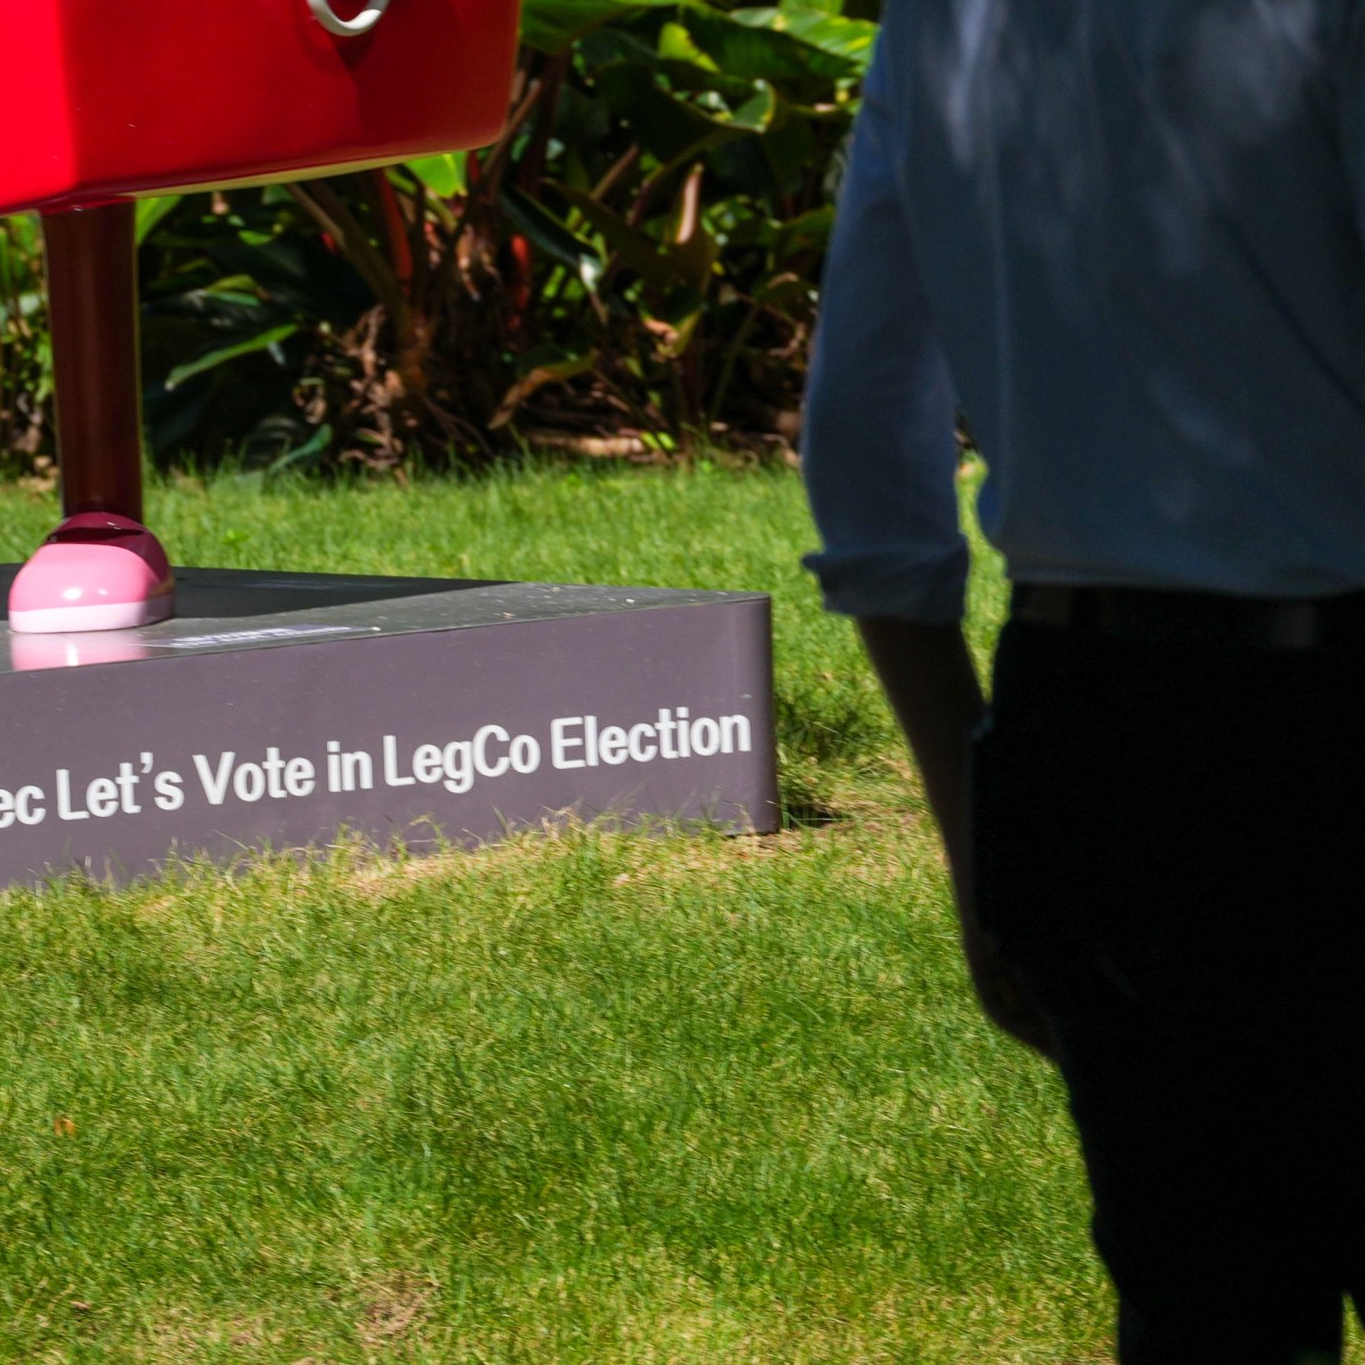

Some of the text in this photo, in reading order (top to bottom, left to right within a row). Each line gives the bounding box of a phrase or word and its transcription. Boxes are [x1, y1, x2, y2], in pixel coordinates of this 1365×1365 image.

[193, 746, 316, 806] Vote
[327, 740, 374, 793] in
[383, 724, 541, 794] LegCo
[551, 706, 752, 770] Election
